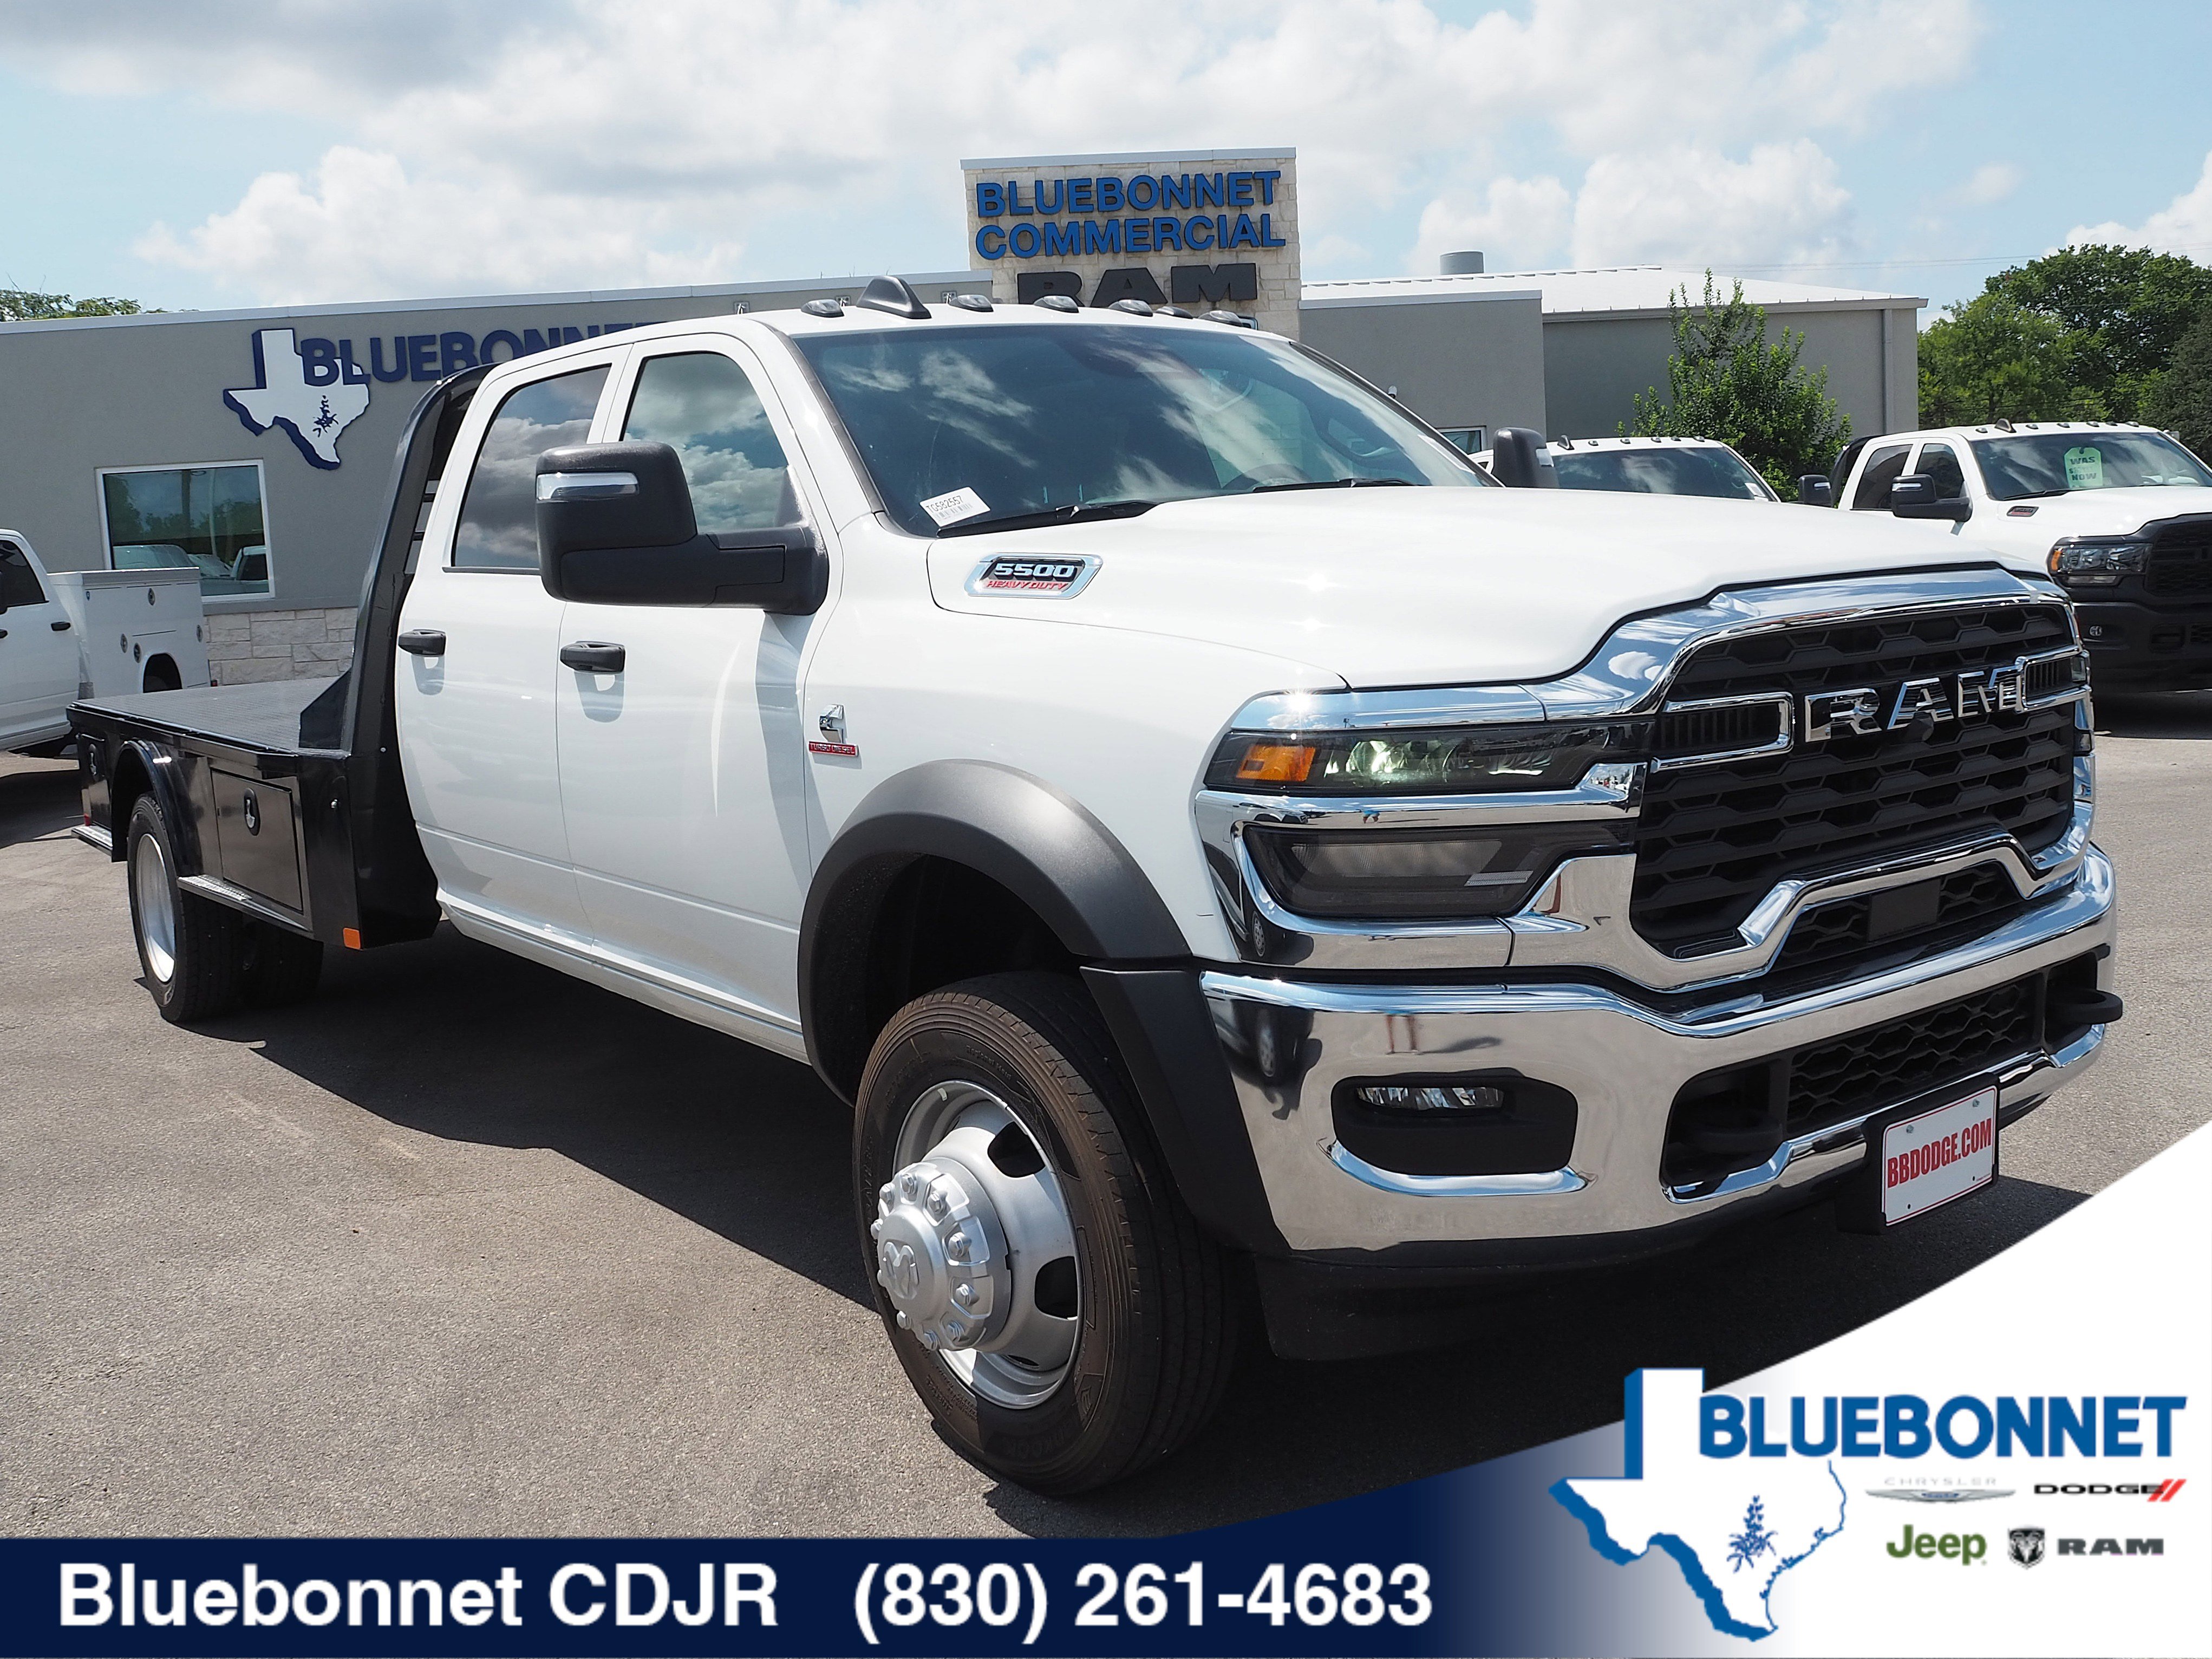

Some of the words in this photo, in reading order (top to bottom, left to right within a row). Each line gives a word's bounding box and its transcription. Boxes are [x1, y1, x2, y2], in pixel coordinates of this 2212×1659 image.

[976, 171, 1281, 217] BLUEBONNET
[976, 213, 1286, 260] COMMERCIAL
[1017, 263, 1257, 308] RAM
[301, 321, 667, 386] BLUEBO
[2070, 457, 2095, 465] WAS
[2071, 473, 2096, 481] NOW
[925, 495, 963, 513] TG582557
[986, 580, 1032, 589] HEAVY
[1028, 581, 1069, 590] DUTY
[993, 562, 1077, 582] 5500
[1805, 666, 2021, 743] RAM
[810, 743, 832, 752] TURBO
[832, 745, 856, 754] DIESEL
[1887, 1117, 1992, 1188] BBDODGE.COM
